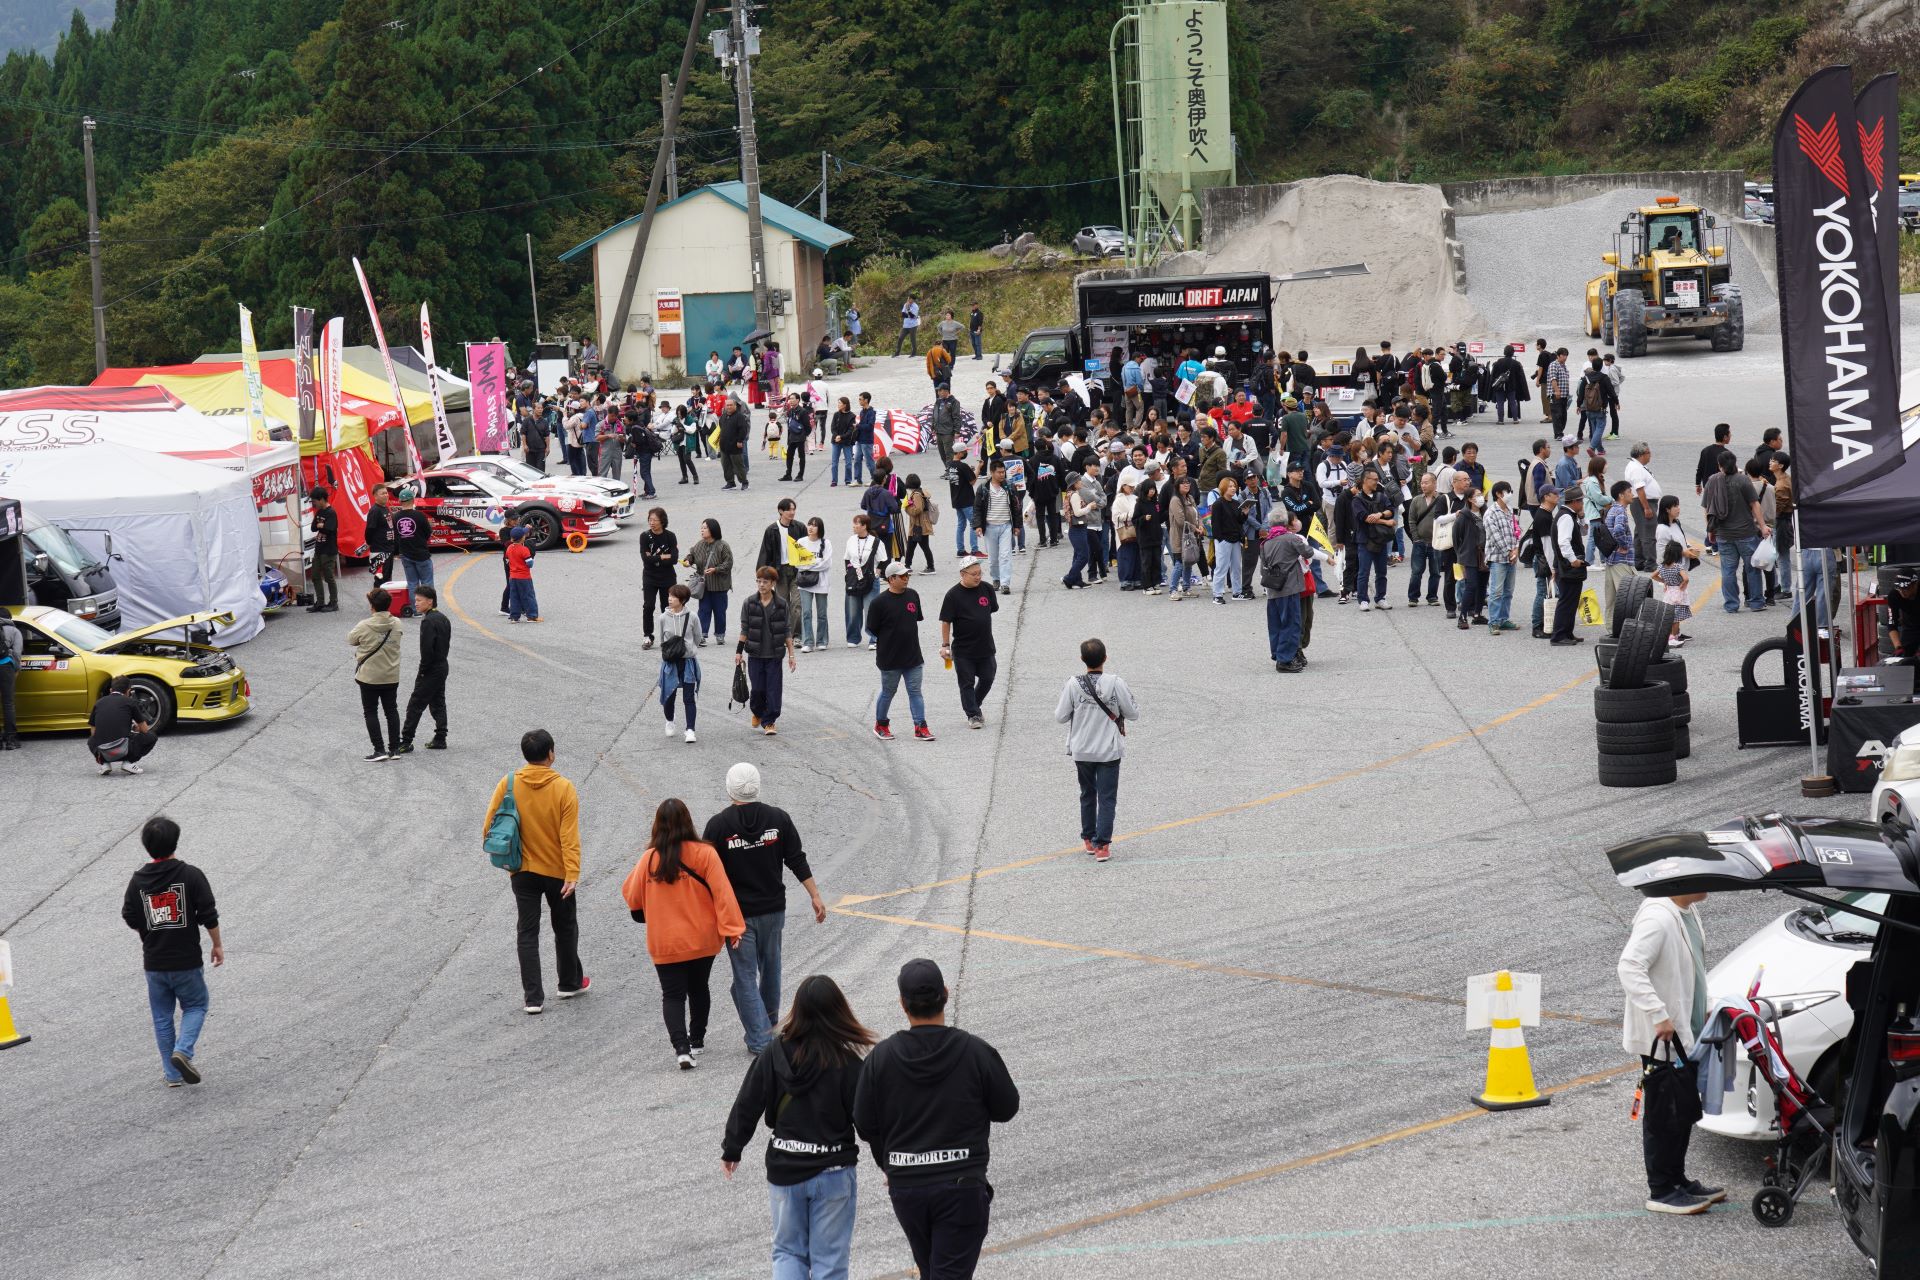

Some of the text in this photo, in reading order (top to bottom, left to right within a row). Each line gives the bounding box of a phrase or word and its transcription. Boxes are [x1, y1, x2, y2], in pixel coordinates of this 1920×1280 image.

[1185, 8, 1208, 163] ようこそ奥伊吹へ
[1138, 288, 1258, 307] FORMULA DRIFT JAPAN
[1813, 196, 1873, 470] YOKOHAMA
[437, 506, 484, 519] MagiVeil
